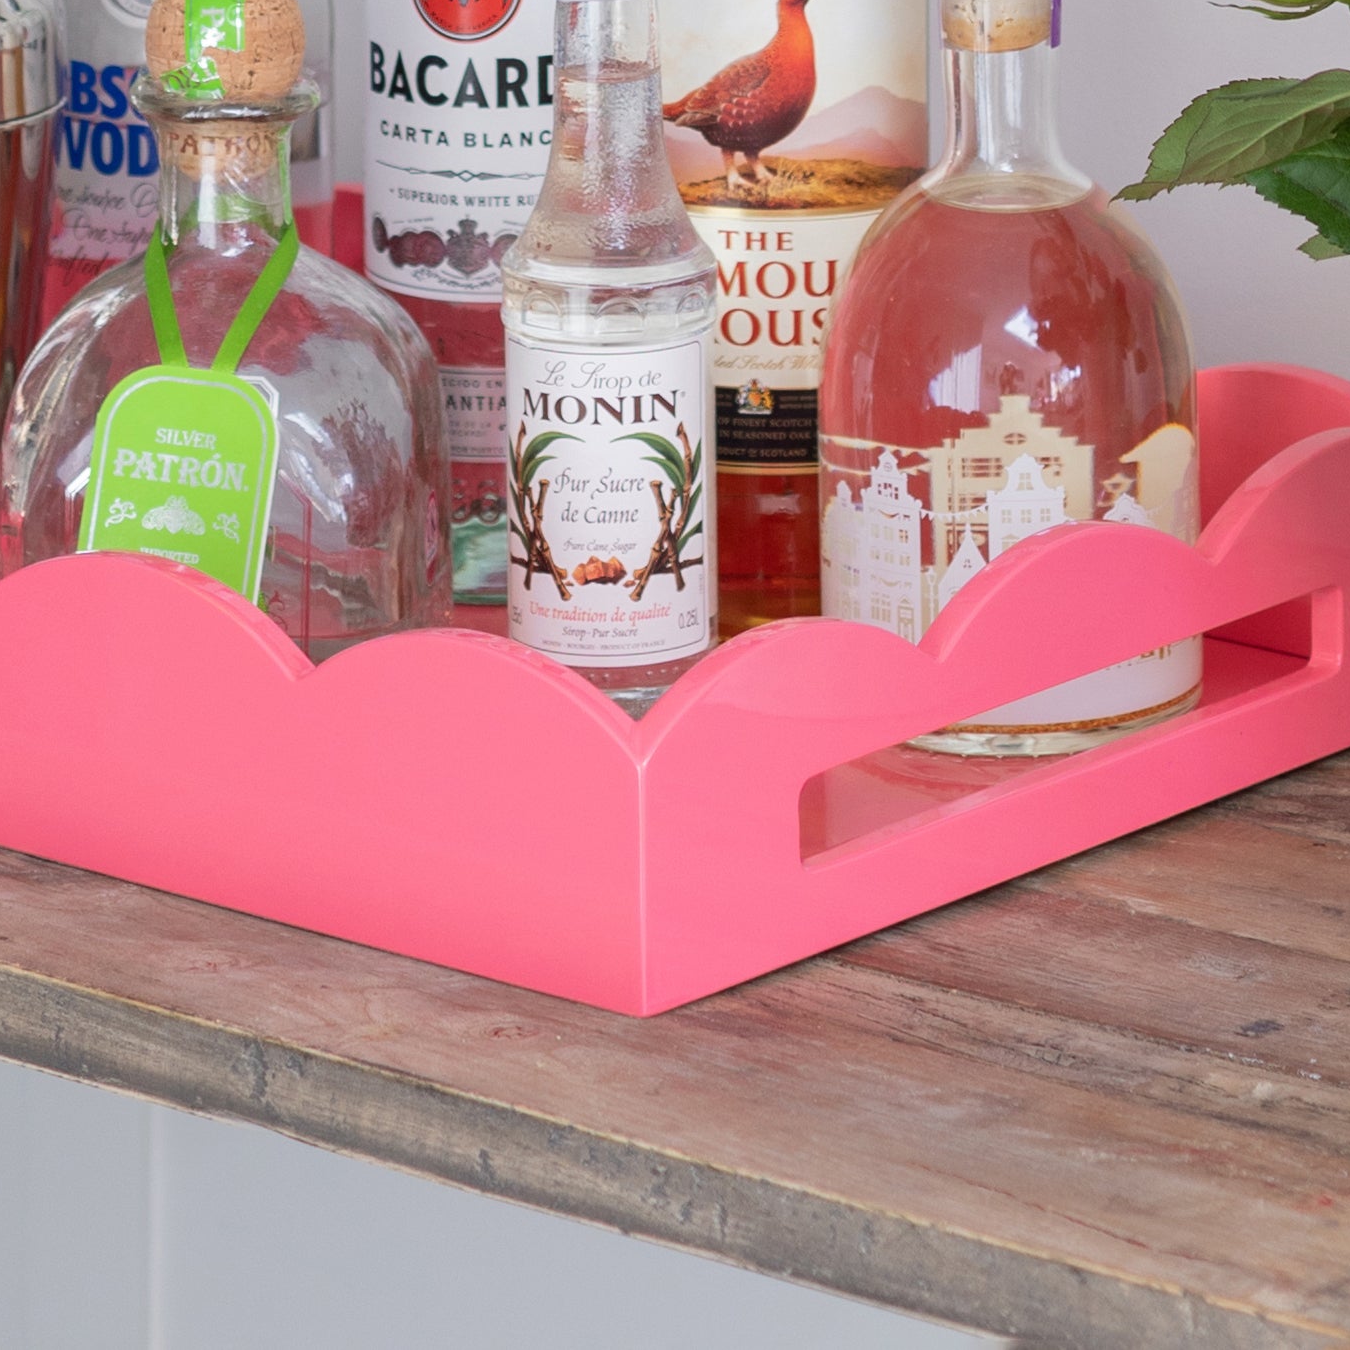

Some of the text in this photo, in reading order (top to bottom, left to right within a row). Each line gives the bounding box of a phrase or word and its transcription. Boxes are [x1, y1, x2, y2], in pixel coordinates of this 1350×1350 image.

[380, 120, 450, 147] CARTA
[397, 187, 459, 207] SUPERIOR
[463, 196, 511, 208] WHITE
[718, 229, 794, 251] THE
[714, 307, 828, 347] OUS
[536, 360, 662, 396] Le Sirop de
[522, 387, 680, 426] MONIN
[154, 427, 218, 450] SILVER
[553, 466, 645, 500] Pur Sucre
[561, 501, 639, 525] de Canne
[529, 600, 673, 627] Une tradition de qualité
